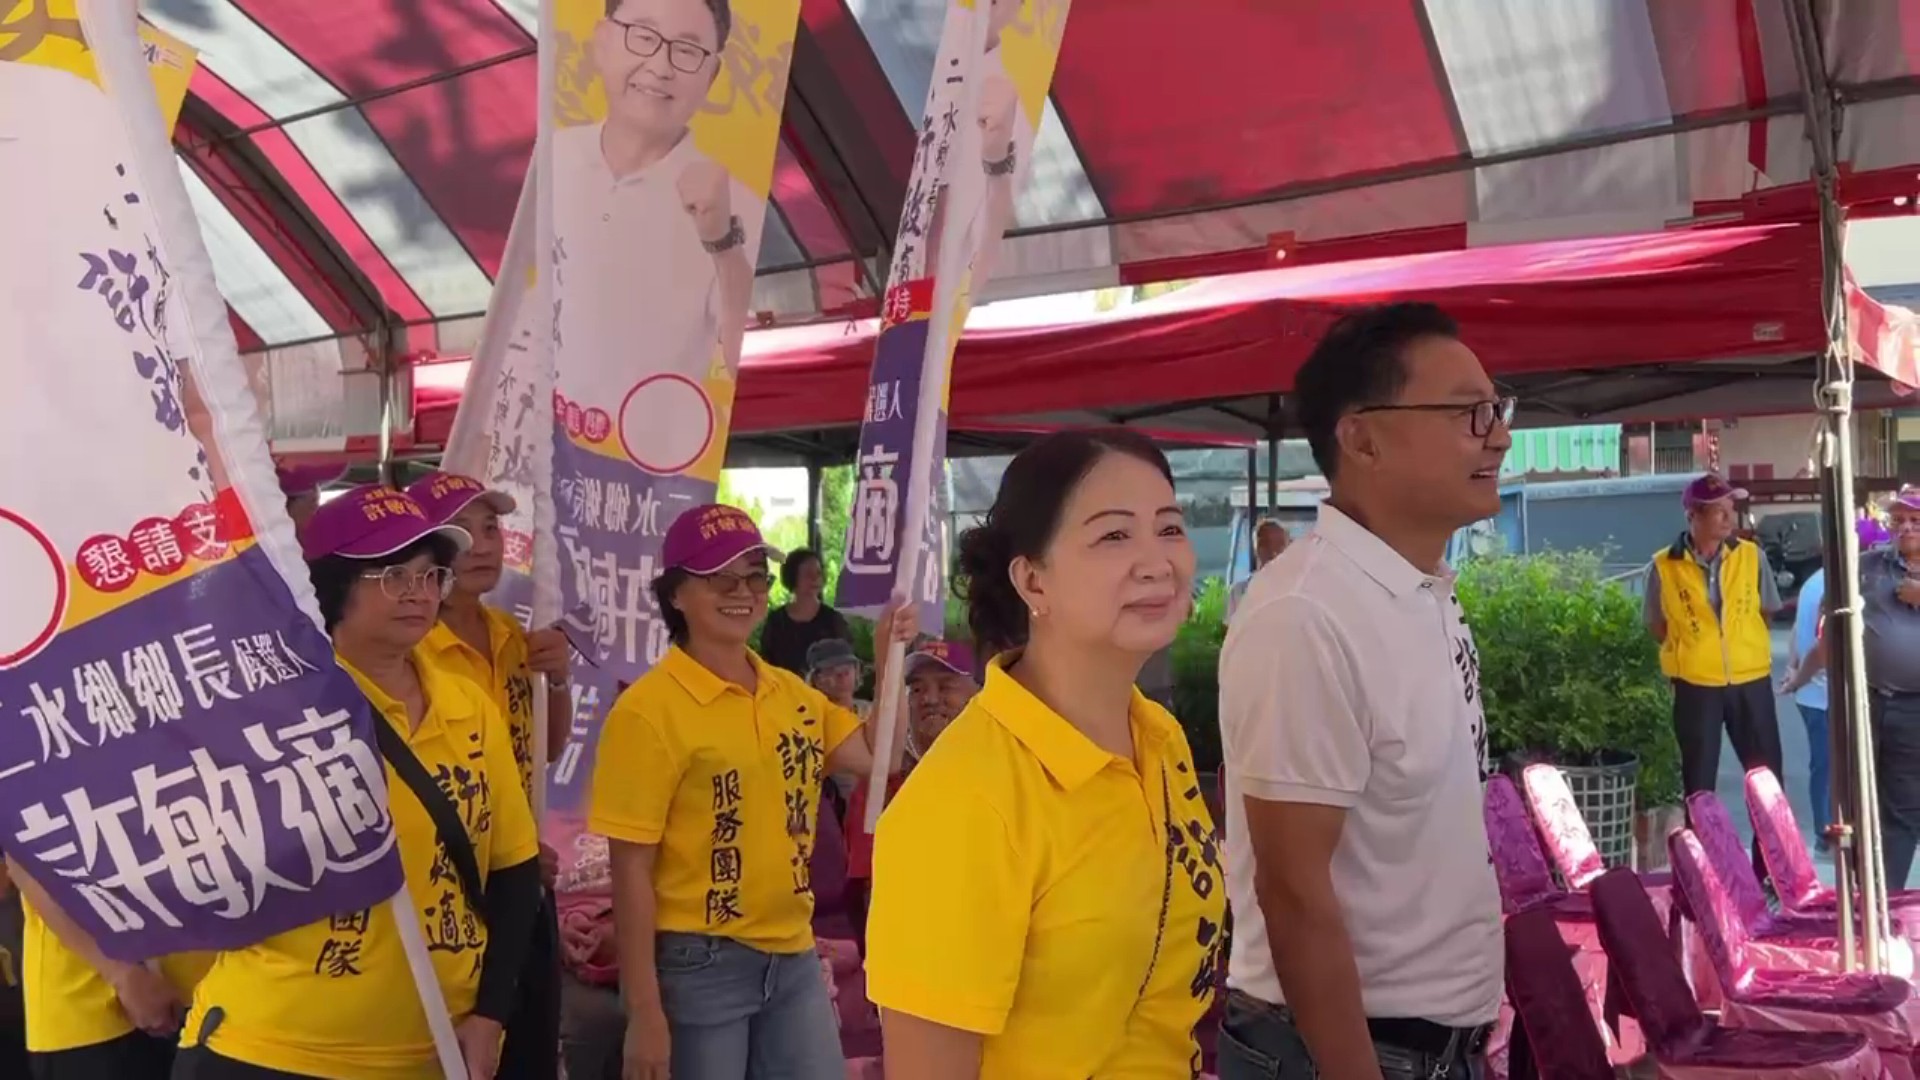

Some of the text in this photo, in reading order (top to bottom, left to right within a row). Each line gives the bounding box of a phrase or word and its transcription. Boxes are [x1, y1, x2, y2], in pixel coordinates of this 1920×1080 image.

[81, 510, 228, 588] 懇請支
[14, 707, 398, 935] 許敏適
[705, 768, 744, 925] 服務團隊
